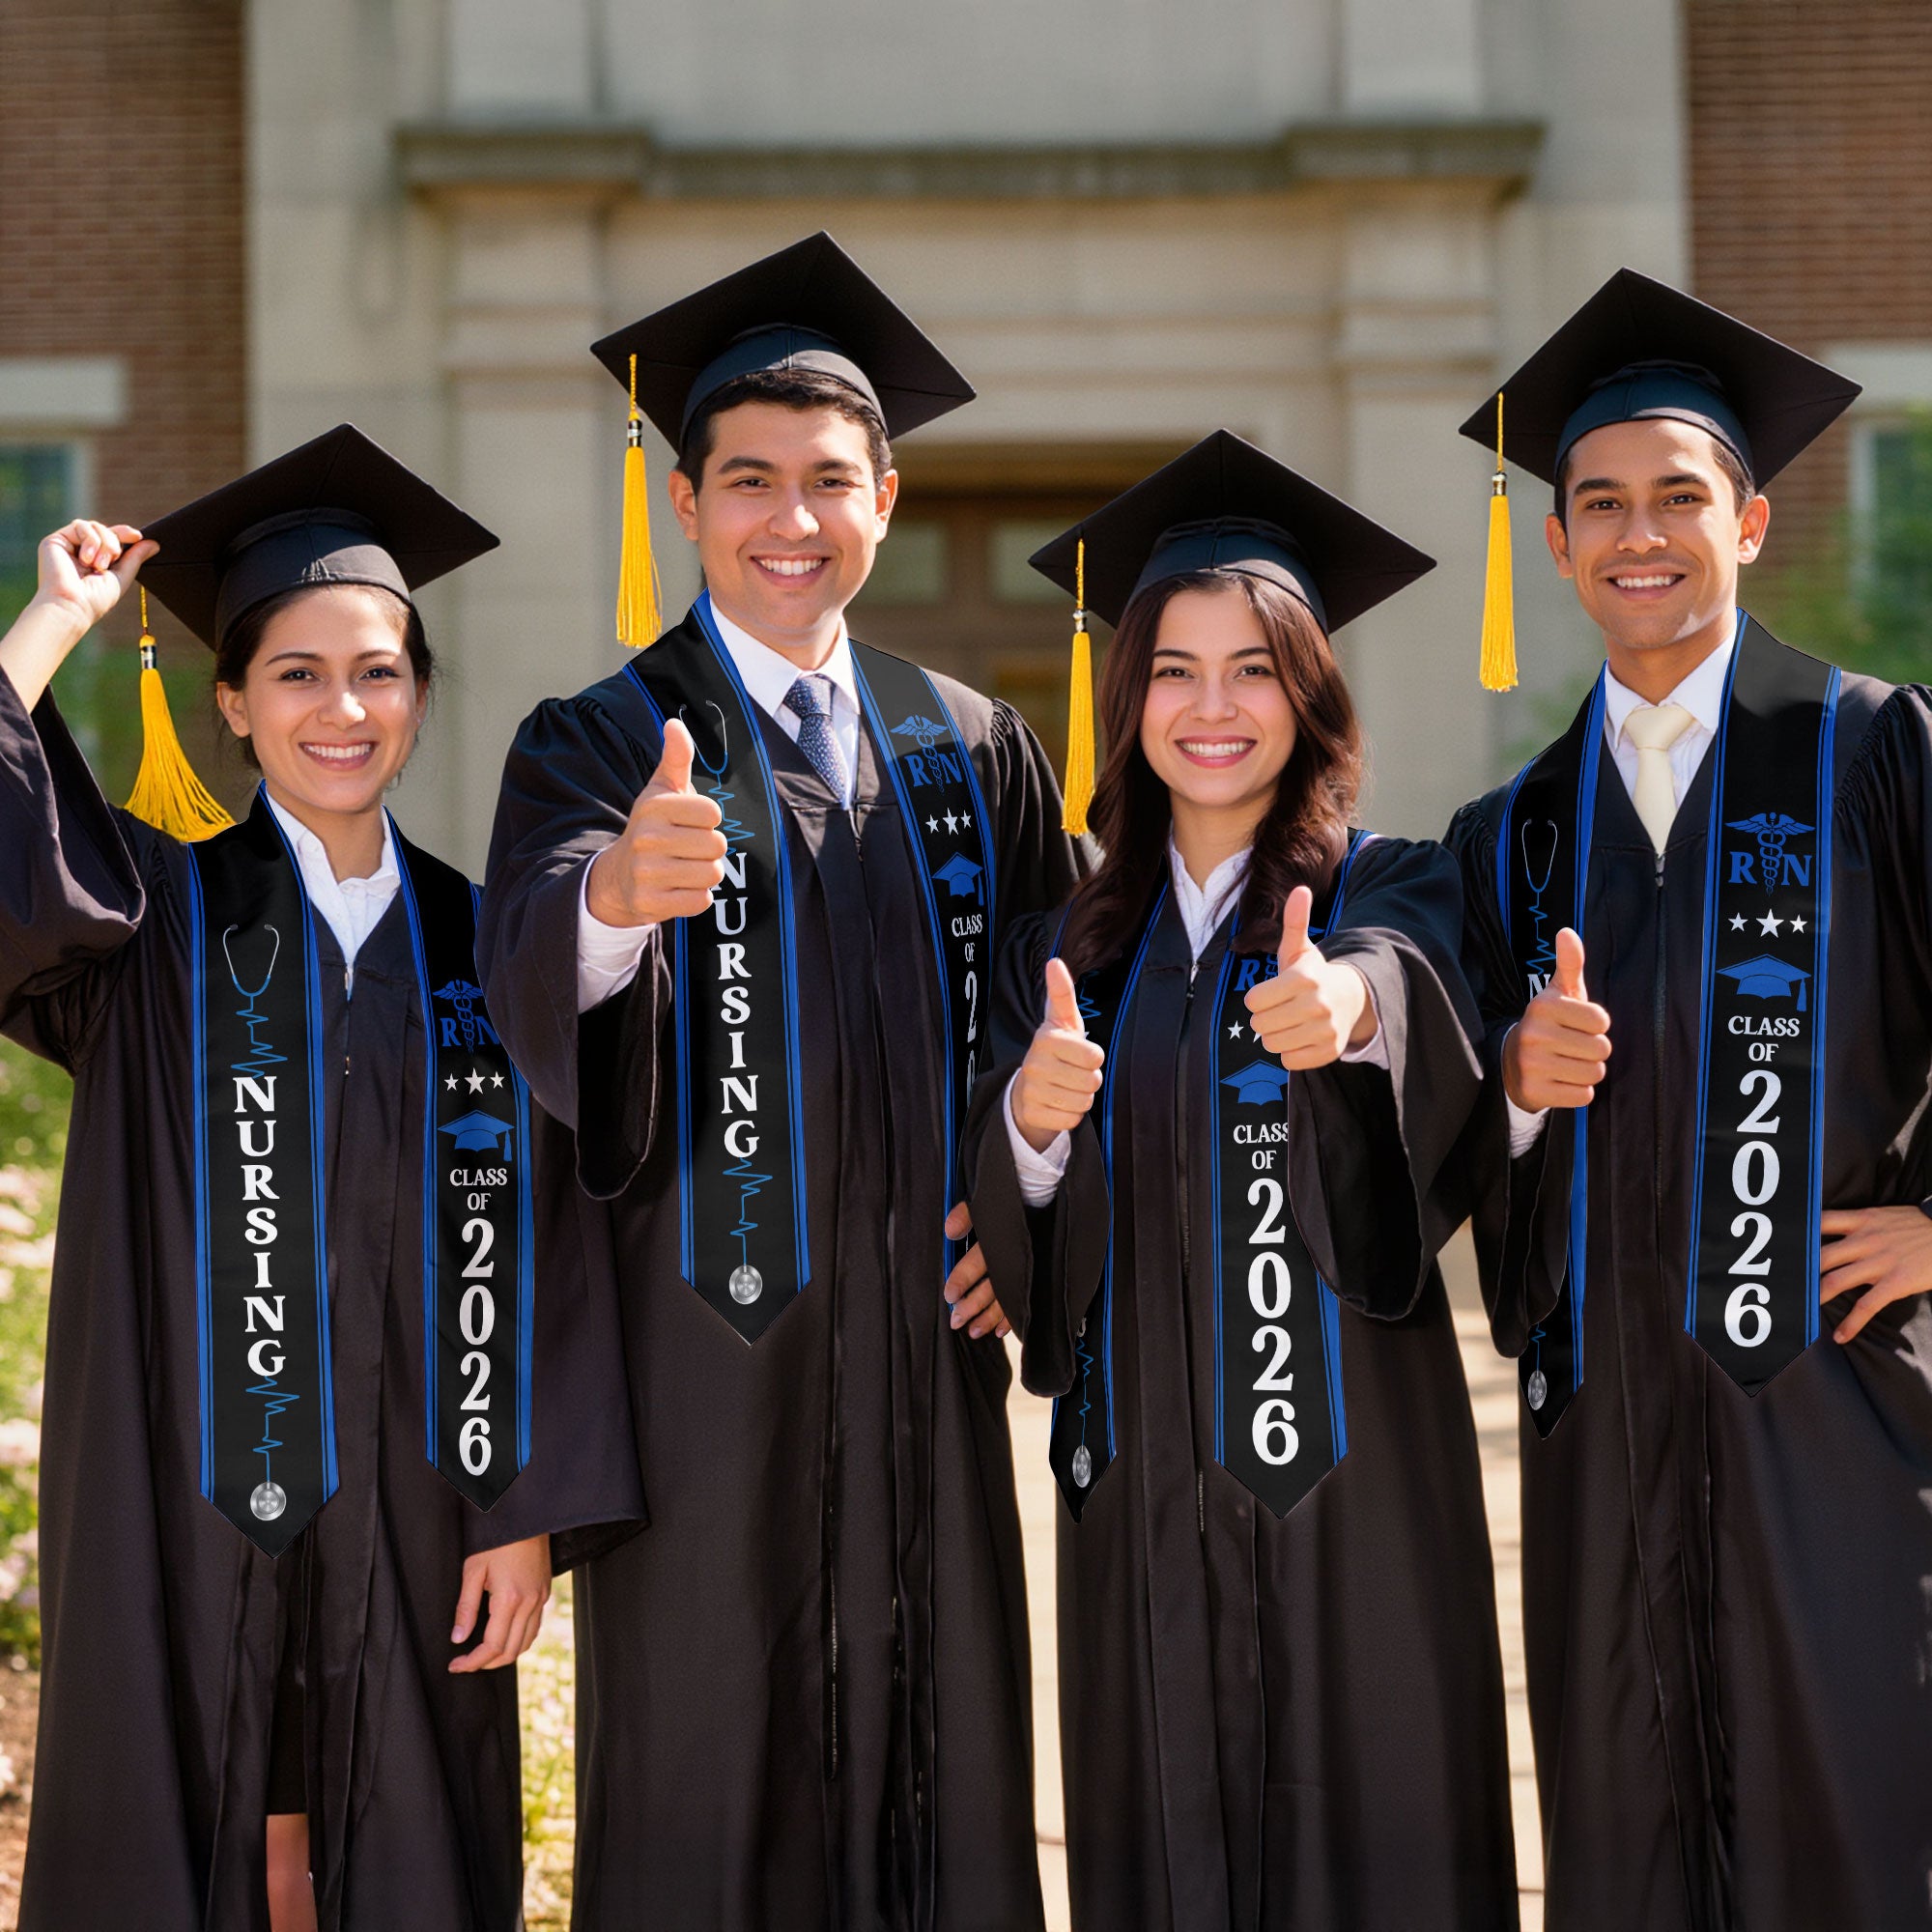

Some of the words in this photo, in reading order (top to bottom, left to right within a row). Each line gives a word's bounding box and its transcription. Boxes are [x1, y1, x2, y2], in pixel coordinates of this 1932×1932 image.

[904, 753, 963, 787] RN
[1728, 851, 1812, 887] RN
[952, 913, 983, 938] CLASS
[964, 942, 976, 963] OF
[710, 852, 760, 1158] NURSING
[1727, 1015, 1801, 1037] CLASS
[1747, 1042, 1780, 1062] OF
[1251, 1150, 1277, 1170] OF
[449, 1168, 508, 1187] CLASS
[467, 1192, 492, 1211] OF
[1723, 1069, 1783, 1348] 2026
[233, 1075, 288, 1378] NURSING
[1247, 1178, 1299, 1465] 2026
[458, 1217, 495, 1476] 2026
